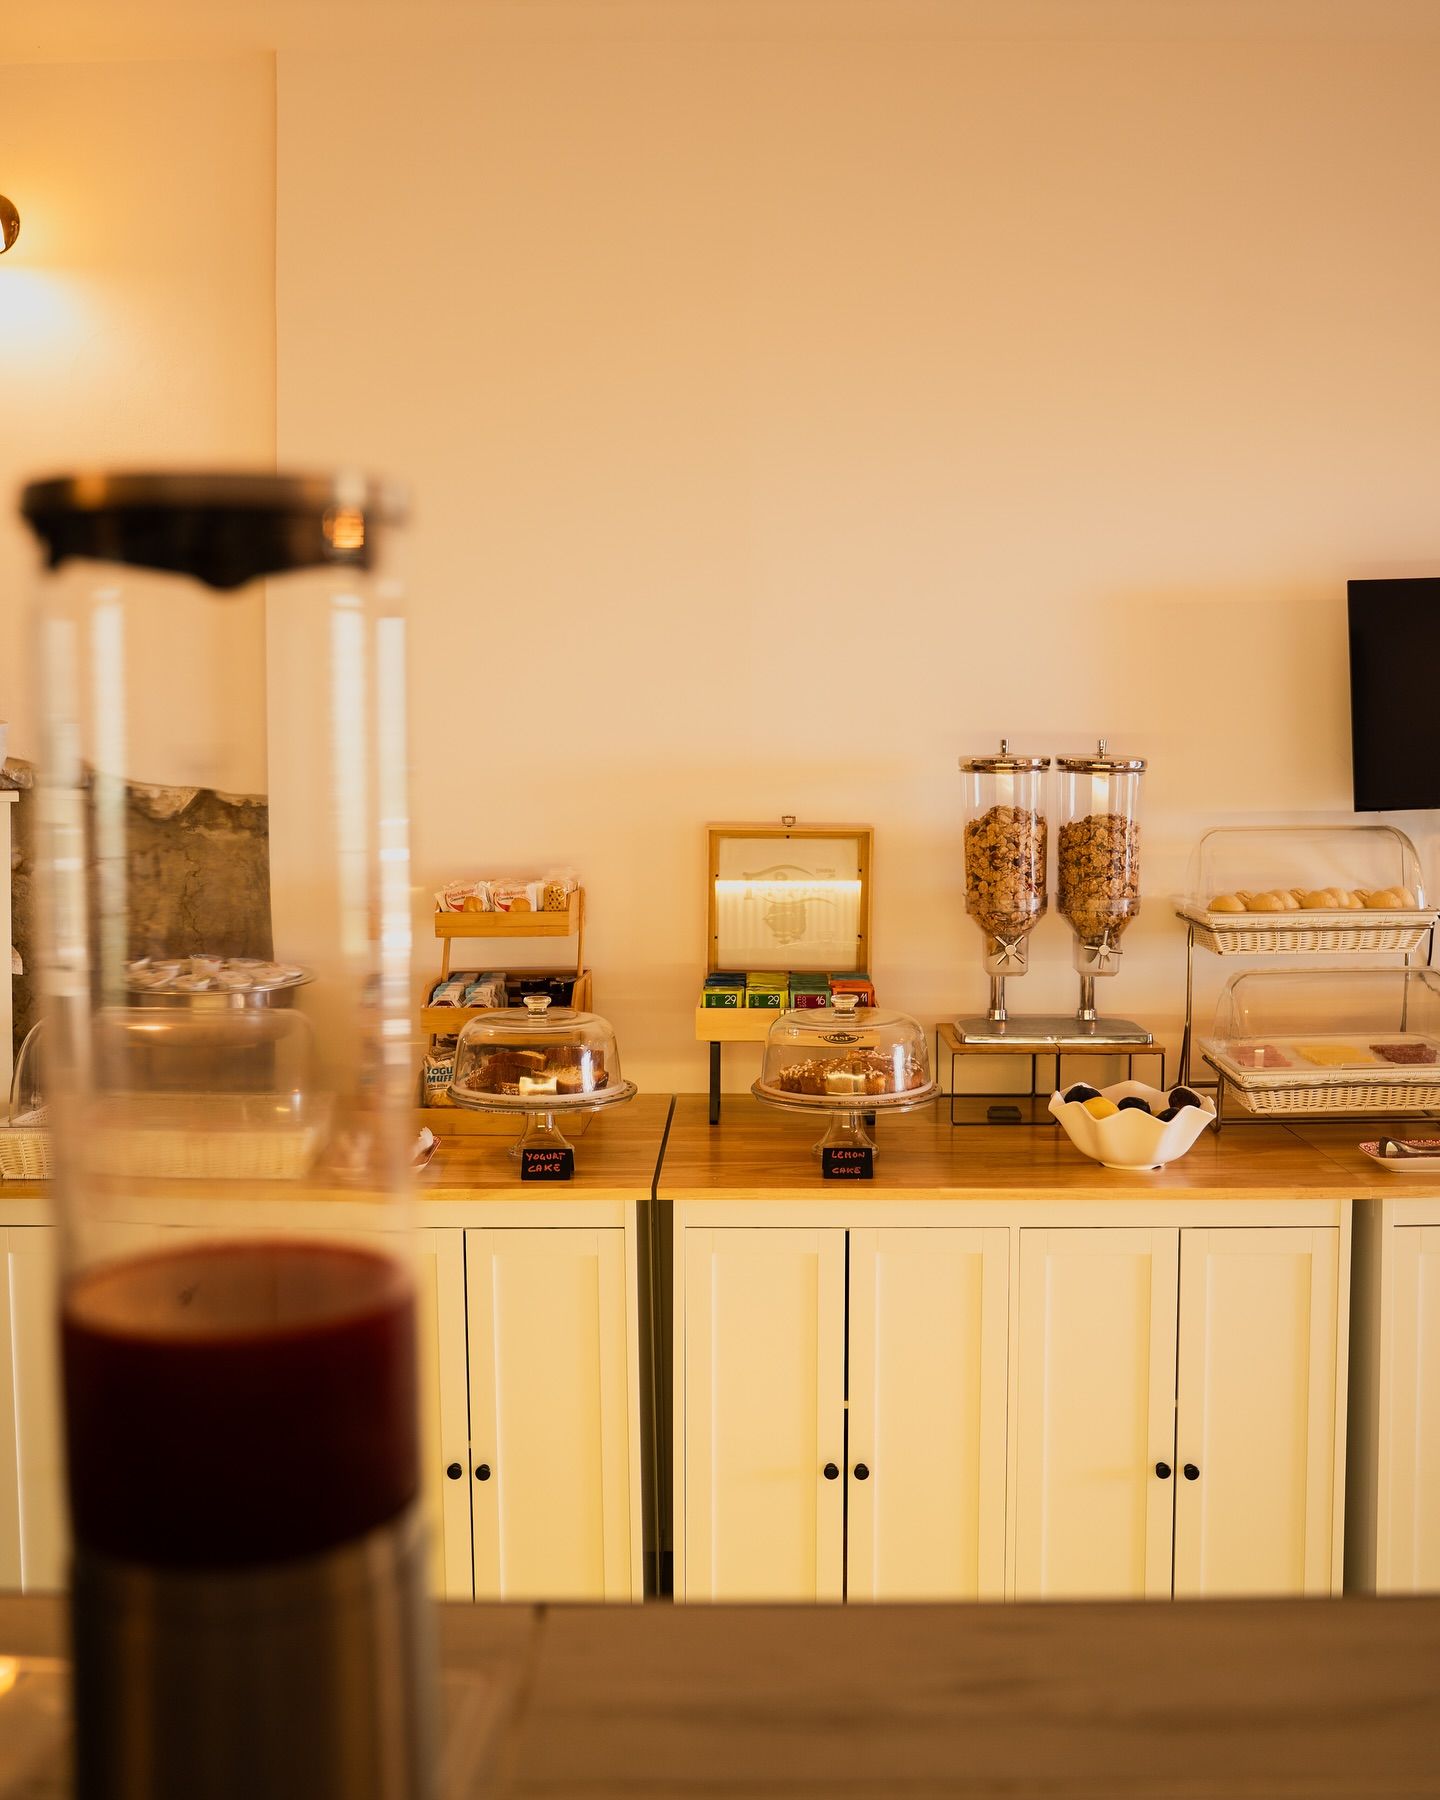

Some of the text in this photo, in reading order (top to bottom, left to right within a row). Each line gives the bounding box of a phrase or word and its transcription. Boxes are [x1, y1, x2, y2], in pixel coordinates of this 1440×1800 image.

[724, 994, 737, 1005] 29
[767, 995, 780, 1005] 29
[815, 995, 826, 1005] 16
[426, 1066, 453, 1075] YOGU
[426, 1075, 453, 1084] MUFF
[525, 1152, 566, 1161] YOGURT
[831, 1150, 865, 1159] LEMON
[528, 1163, 561, 1173] CAKE
[831, 1166, 861, 1174] CAKE
